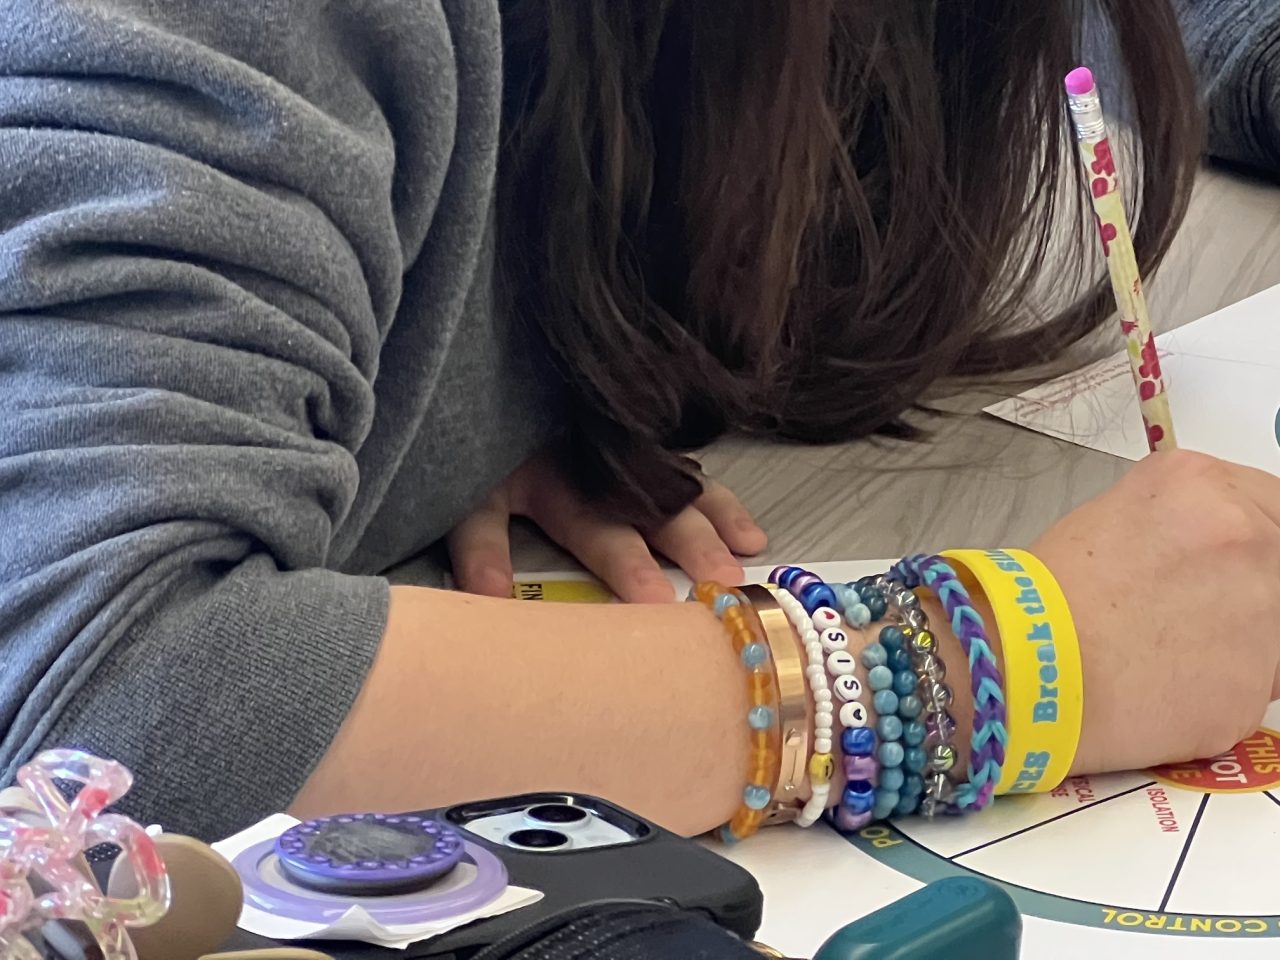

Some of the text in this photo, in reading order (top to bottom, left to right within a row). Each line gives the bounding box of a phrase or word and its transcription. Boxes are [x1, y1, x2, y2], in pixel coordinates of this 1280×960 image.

[1015, 576, 1045, 615] the
[1027, 622, 1058, 723] Break
[1146, 787, 1179, 832] ISOLATION
[1102, 908, 1268, 934] CONTROL
